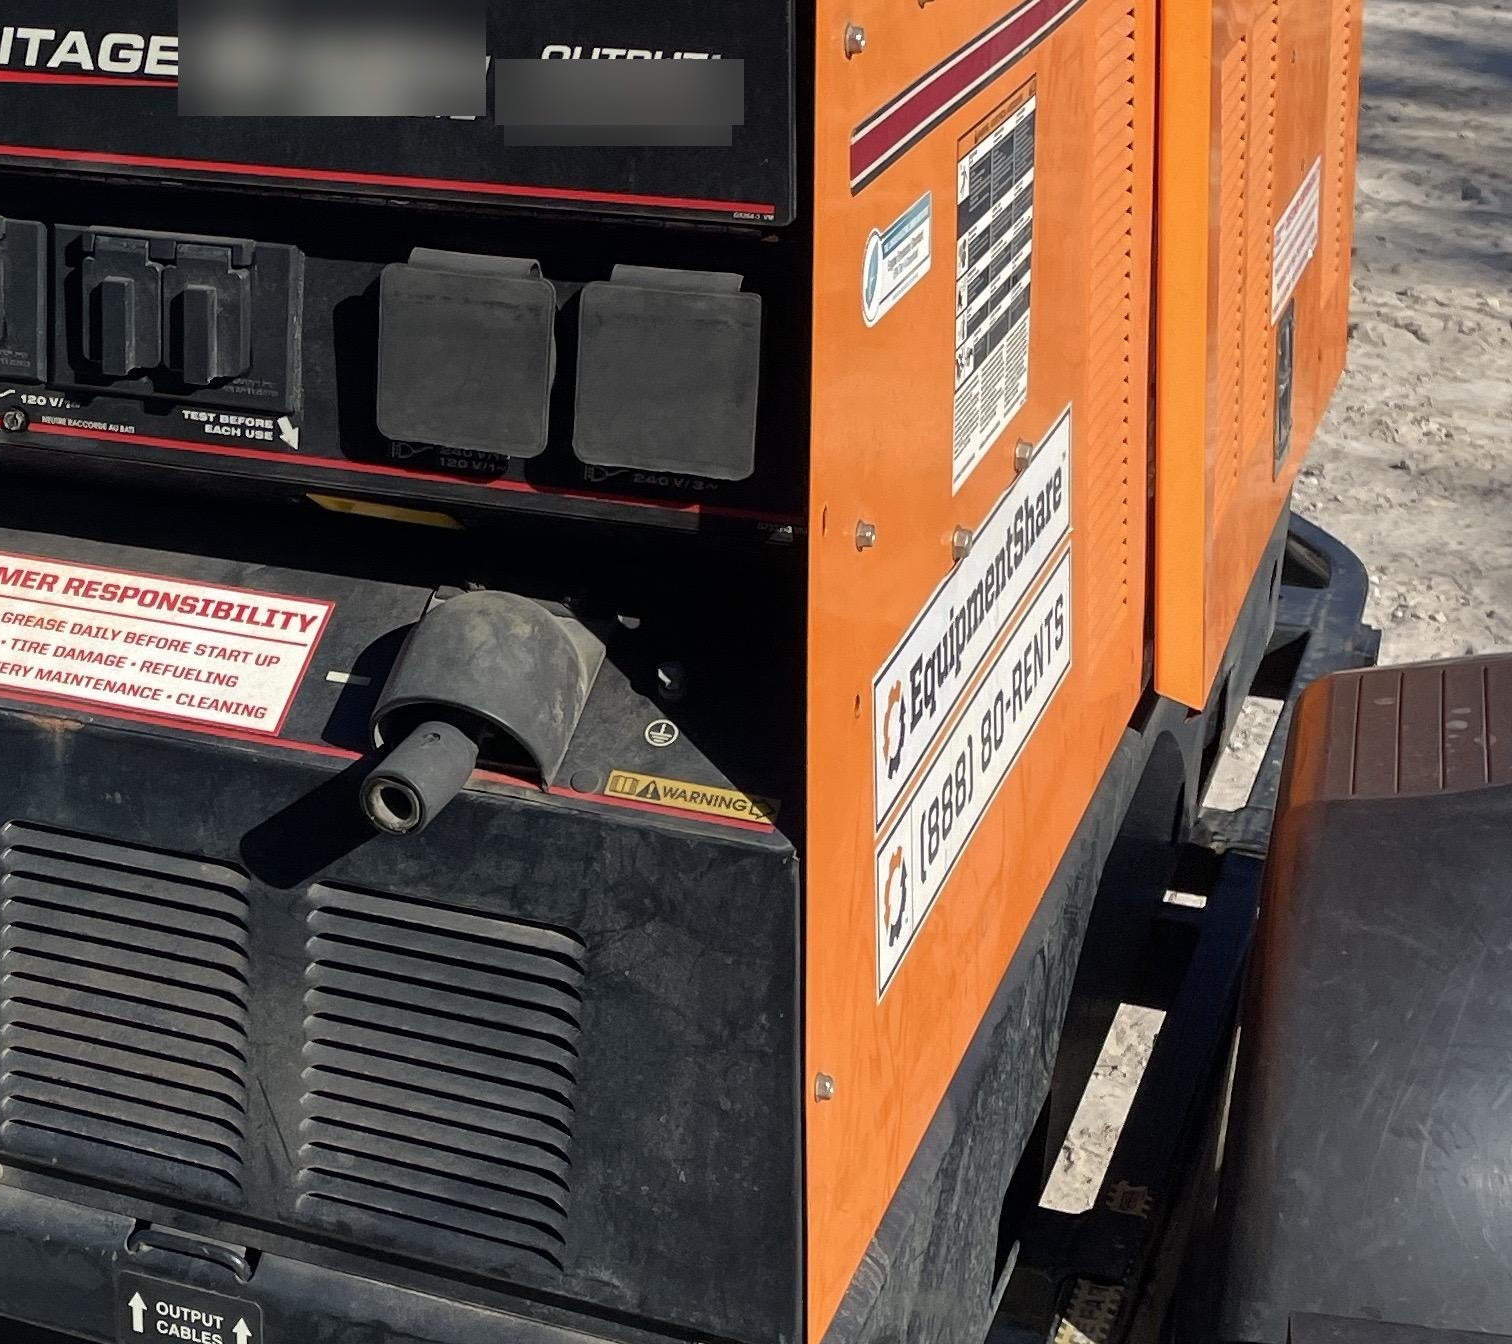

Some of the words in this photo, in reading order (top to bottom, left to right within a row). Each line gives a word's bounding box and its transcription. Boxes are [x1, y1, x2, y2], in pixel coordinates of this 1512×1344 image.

[20, 393, 48, 407] 120
[182, 410, 217, 423] TEST
[218, 413, 274, 430] BEFORE
[204, 424, 242, 438] EACH
[244, 429, 274, 442] USE
[632, 473, 669, 488] 240
[62, 575, 319, 634] RESPONSIBILITY
[908, 467, 1064, 734] EquipmentShare
[0, 609, 67, 633] GREASE
[70, 619, 122, 642] DAILY
[124, 628, 192, 654] BEFORE
[194, 640, 255, 666] START
[255, 651, 282, 669] UP
[10, 637, 50, 657] TIRE
[51, 643, 127, 670] DAMAGE
[139, 659, 240, 690] REFUELING
[34, 665, 164, 702] MAINTENANCE
[175, 691, 269, 721] CLEANING
[920, 734, 974, 884] (888)
[979, 591, 1065, 776] 80-RENTS
[662, 785, 749, 813] WARNING
[154, 1301, 225, 1330] OUTPUT
